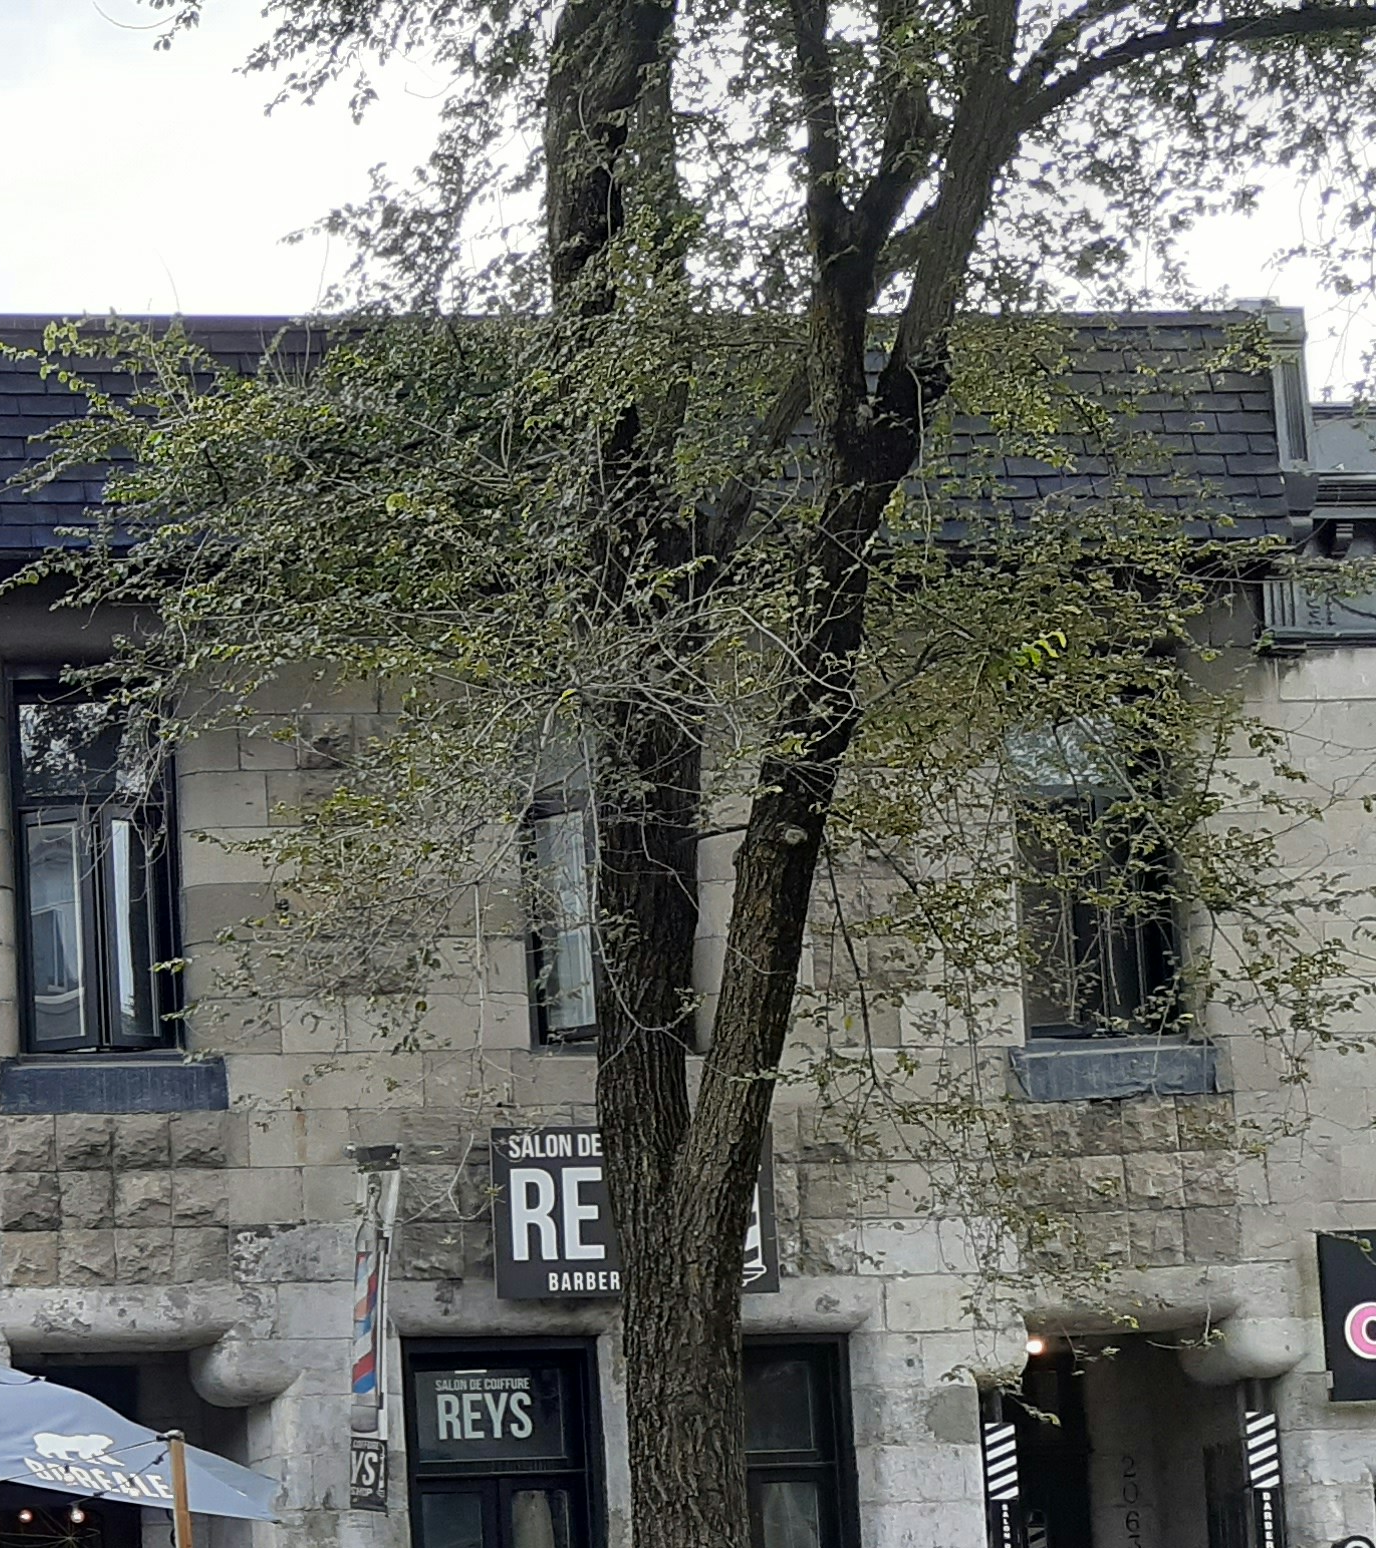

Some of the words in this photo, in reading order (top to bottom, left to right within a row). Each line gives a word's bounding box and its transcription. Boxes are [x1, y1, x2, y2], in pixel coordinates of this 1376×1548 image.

[508, 1133, 573, 1159] SALON
[577, 1132, 604, 1158] DE
[509, 1166, 606, 1262] RE
[548, 1270, 621, 1292] BARBER
[435, 1378, 468, 1391] SALON
[469, 1378, 483, 1391] DE
[484, 1377, 531, 1391] COIFFURE
[436, 1391, 533, 1441] REYS
